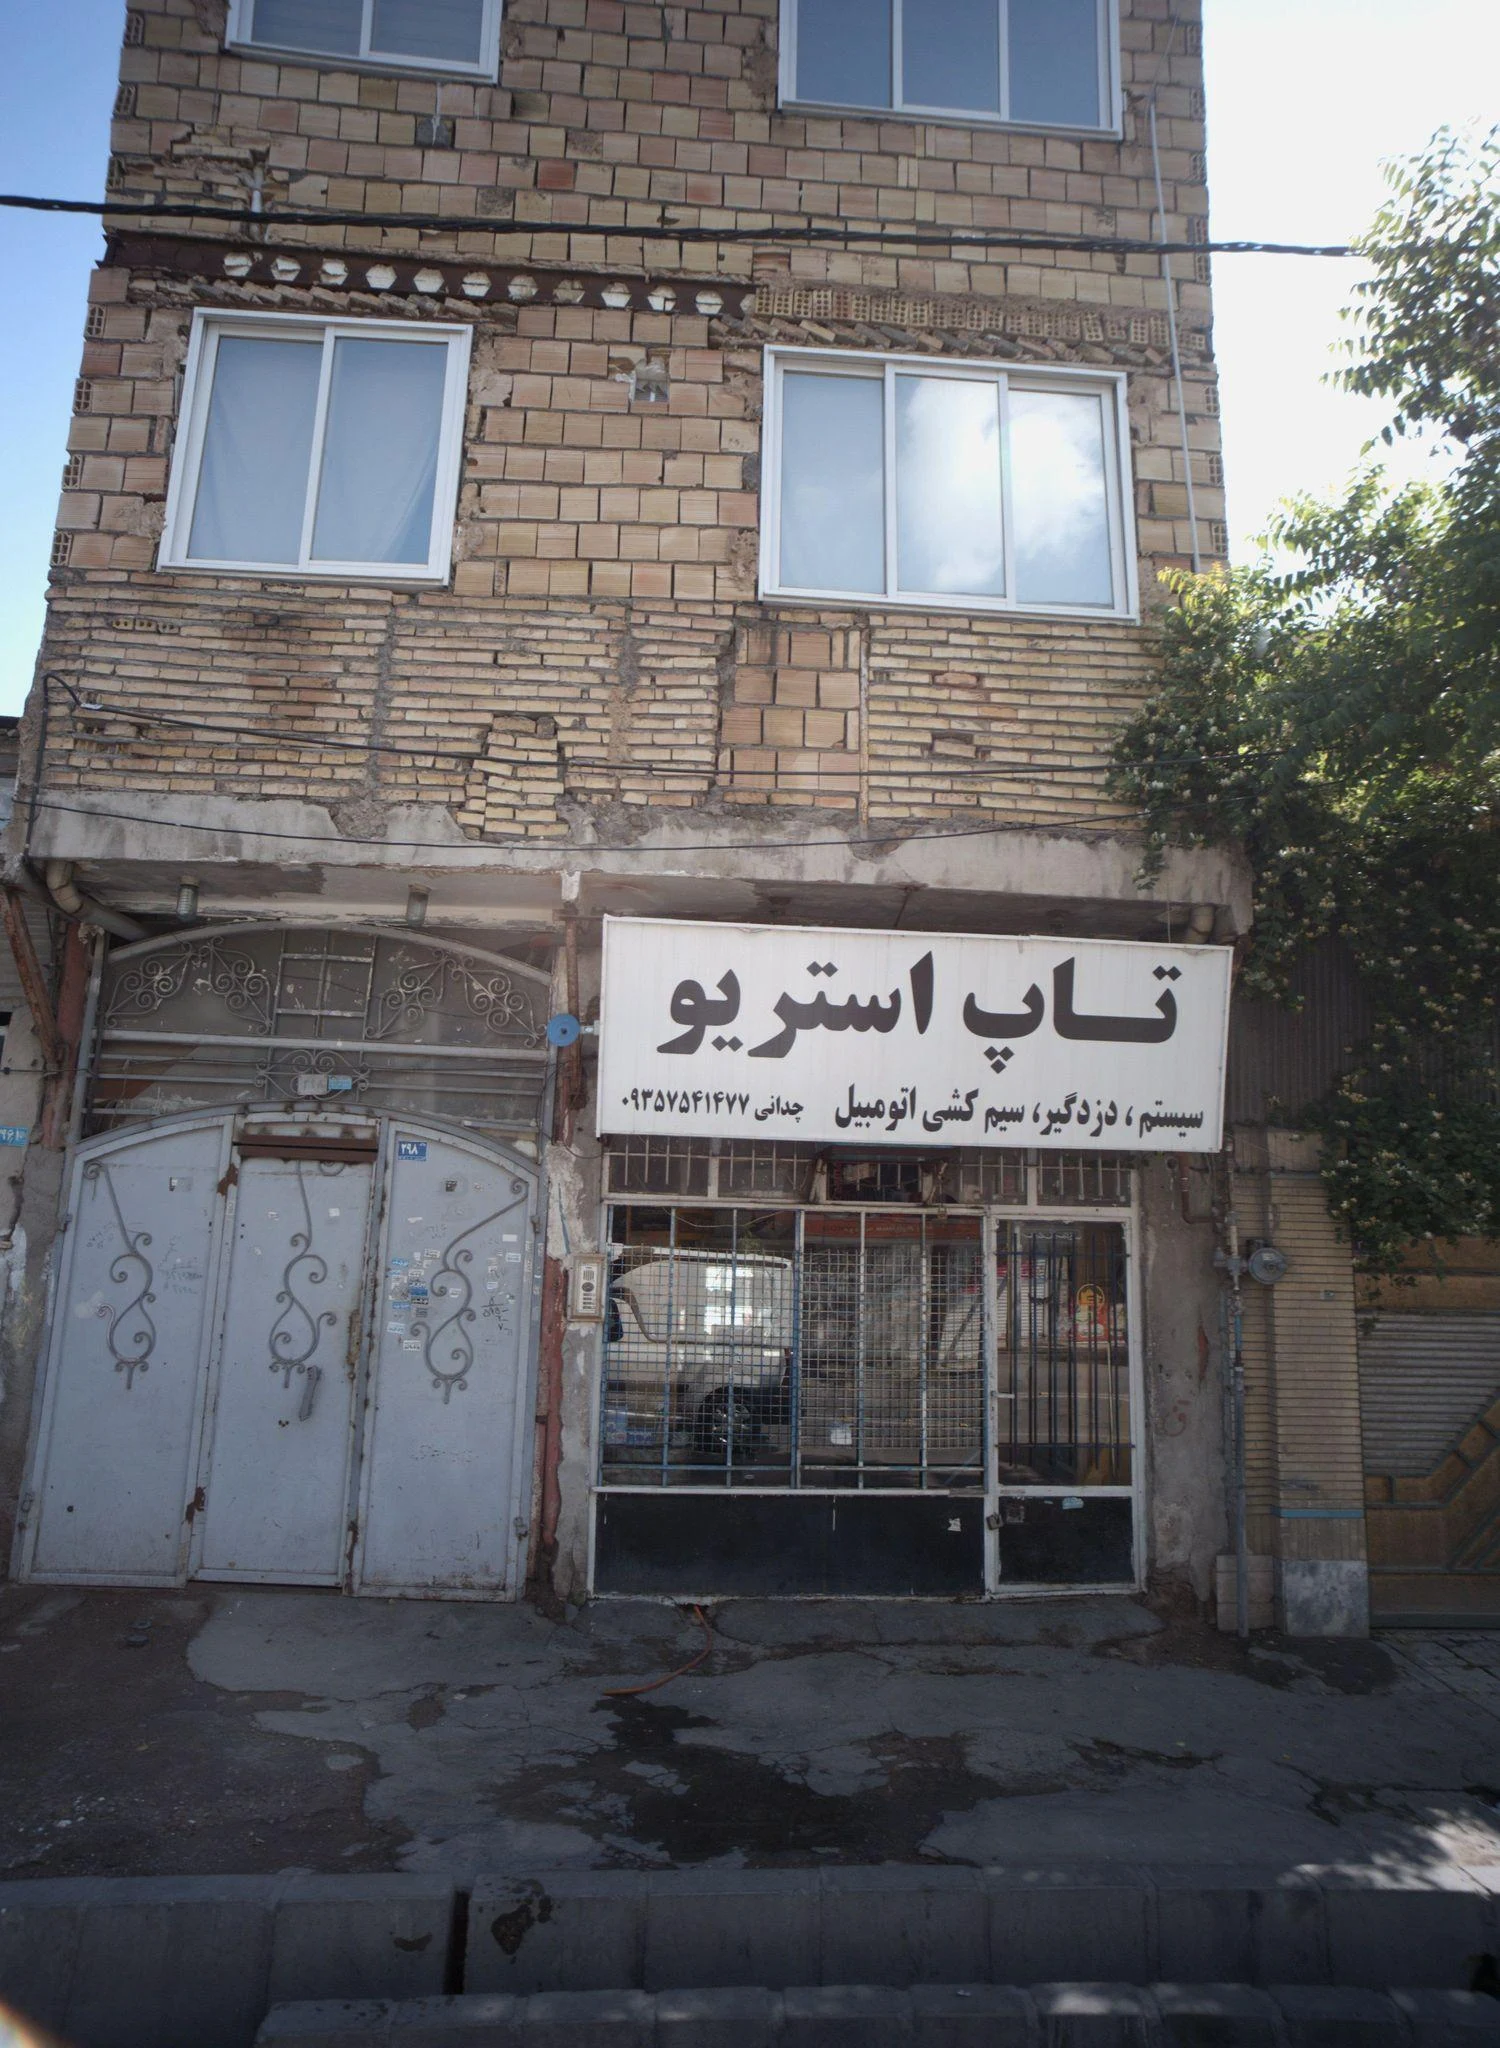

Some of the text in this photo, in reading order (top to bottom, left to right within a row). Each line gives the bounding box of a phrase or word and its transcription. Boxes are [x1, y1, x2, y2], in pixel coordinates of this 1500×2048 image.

[656, 950, 1183, 1074] تاپ استریو
[621, 1086, 751, 1115] ۰۹۳۵۷۵۴۱۴۷۷
[834, 1082, 917, 1133] اتومبیل
[922, 1087, 980, 1133] کشی
[983, 1104, 1026, 1134] سیم
